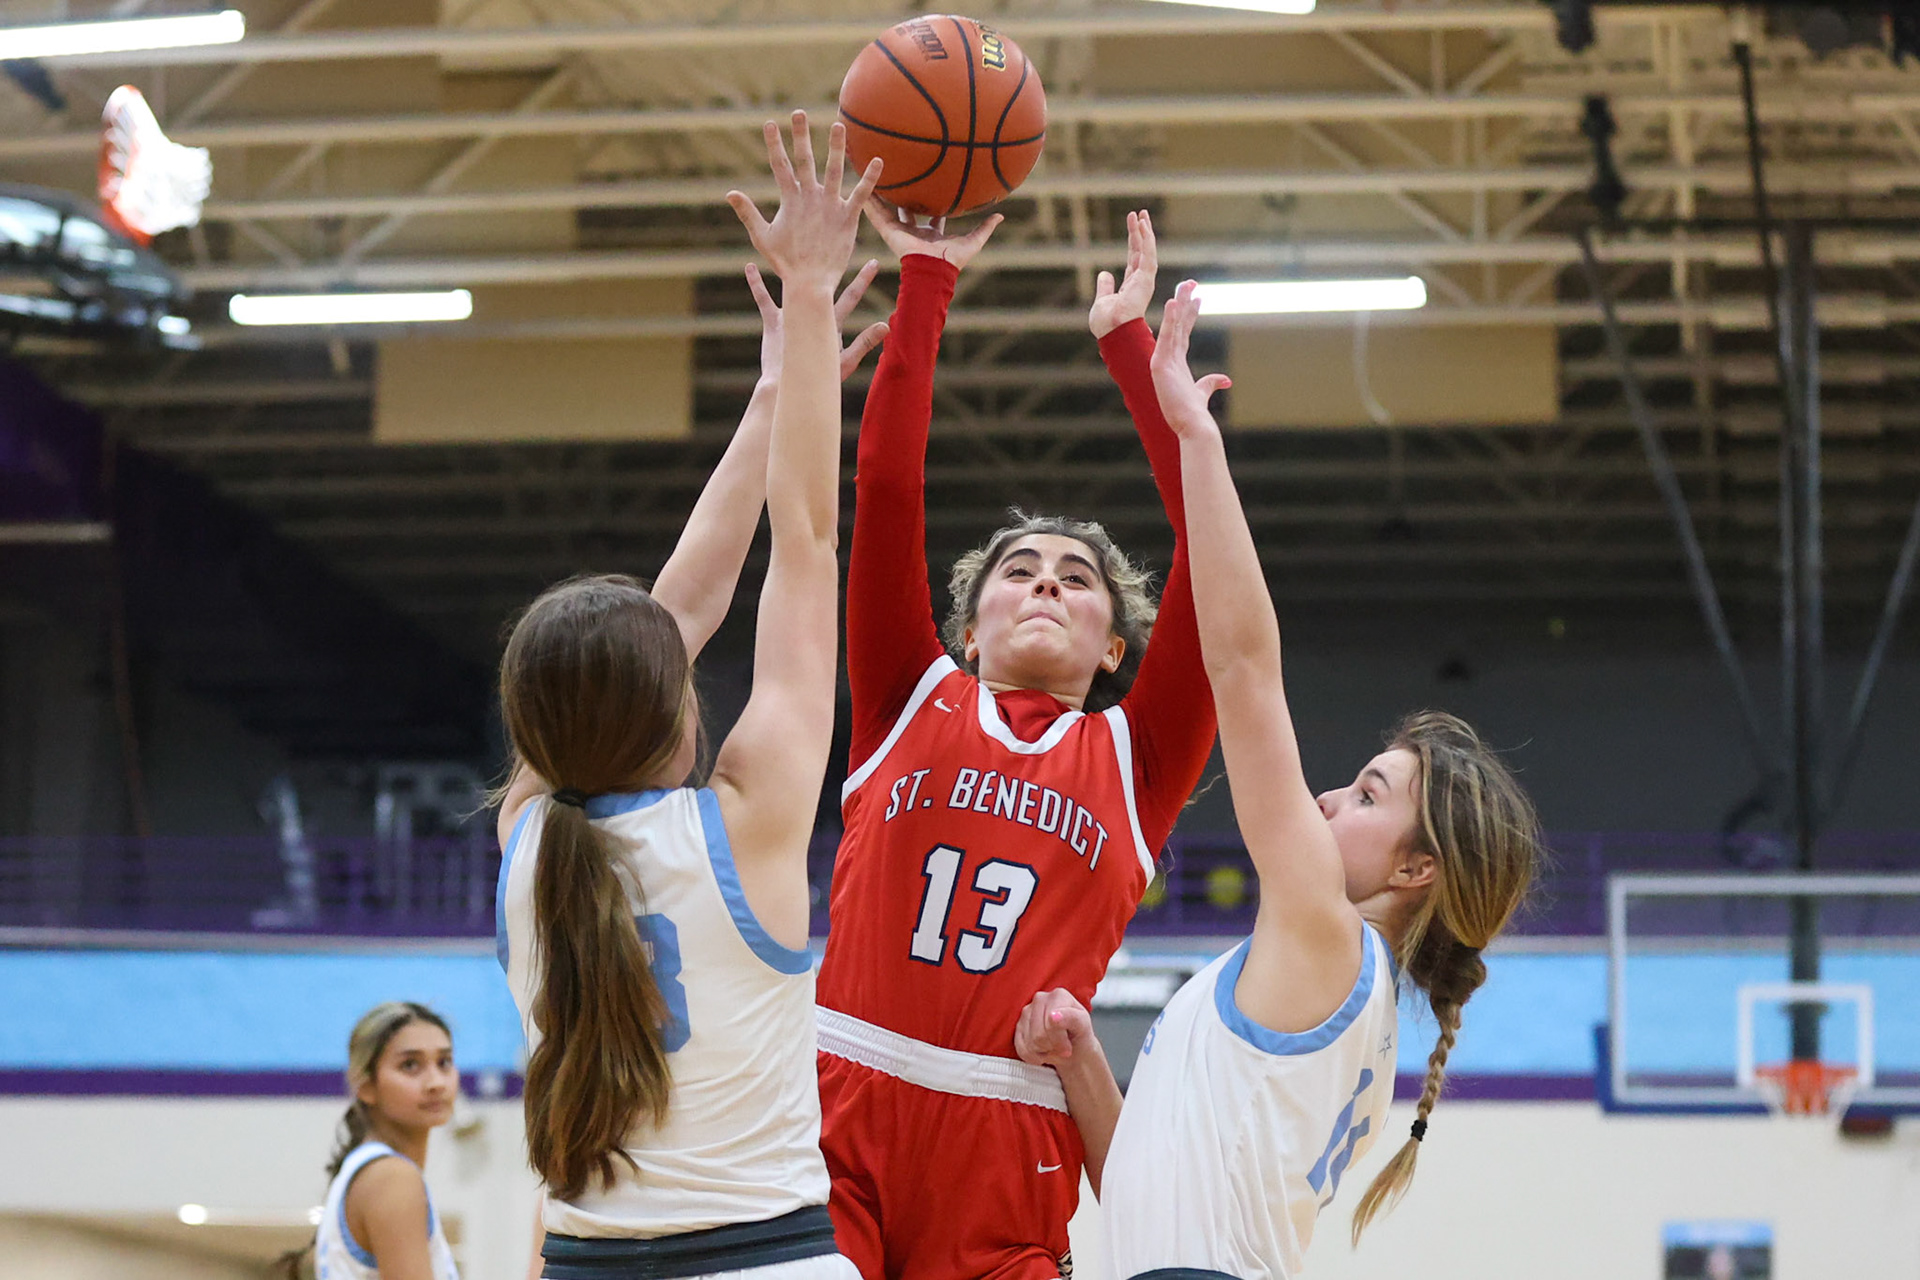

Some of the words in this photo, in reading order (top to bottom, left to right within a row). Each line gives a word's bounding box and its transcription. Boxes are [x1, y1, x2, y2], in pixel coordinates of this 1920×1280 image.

[884, 767, 933, 822] ST.
[948, 766, 1109, 871] BENEDICT
[908, 843, 1040, 975] 13
